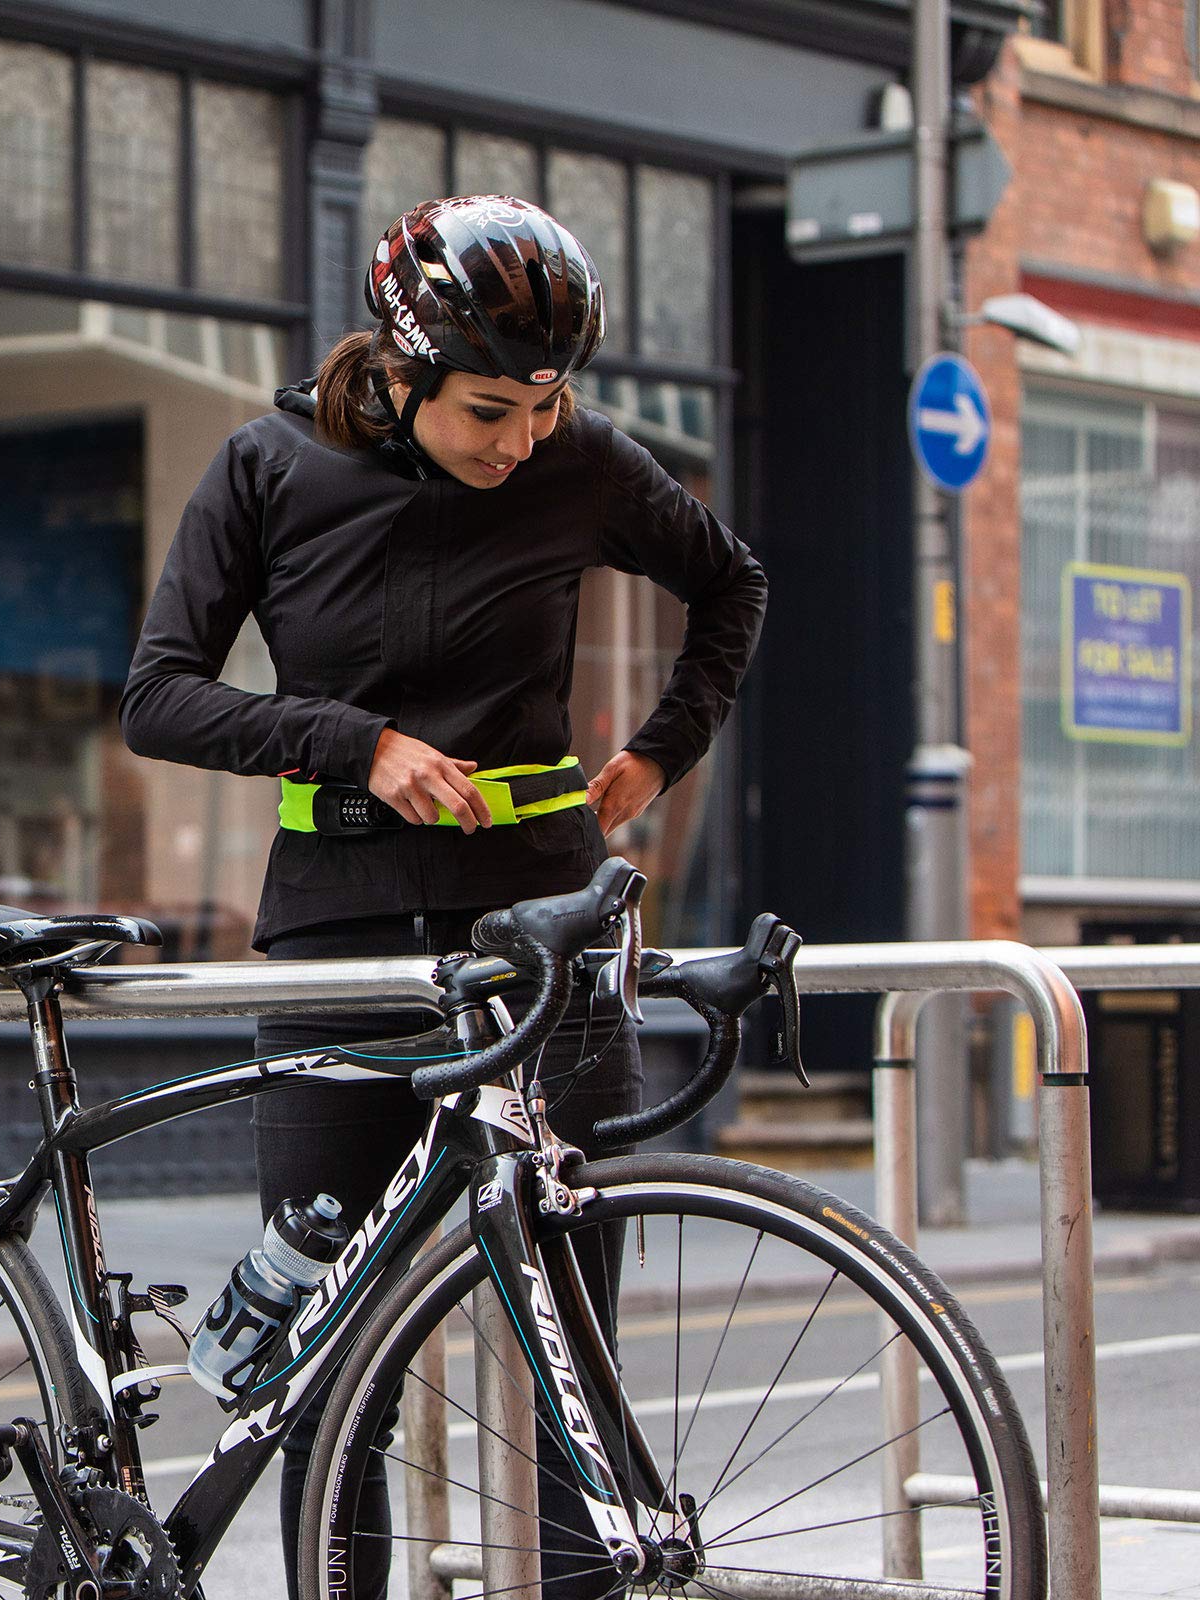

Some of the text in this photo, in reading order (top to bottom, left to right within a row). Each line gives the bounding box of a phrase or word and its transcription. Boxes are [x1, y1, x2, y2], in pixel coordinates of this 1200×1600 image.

[534, 371, 553, 380] BELL
[288, 1108, 442, 1359] RIDLEY
[822, 1207, 862, 1239] Continental
[906, 1271, 935, 1300] PRIX
[520, 1262, 611, 1476] RIDLEY
[339, 1454, 348, 1474] AERO
[333, 1473, 344, 1502] SEASON
[330, 1502, 338, 1523] FOUR
[58, 1525, 81, 1570] RIVAL
[328, 1530, 347, 1600] HUNT
